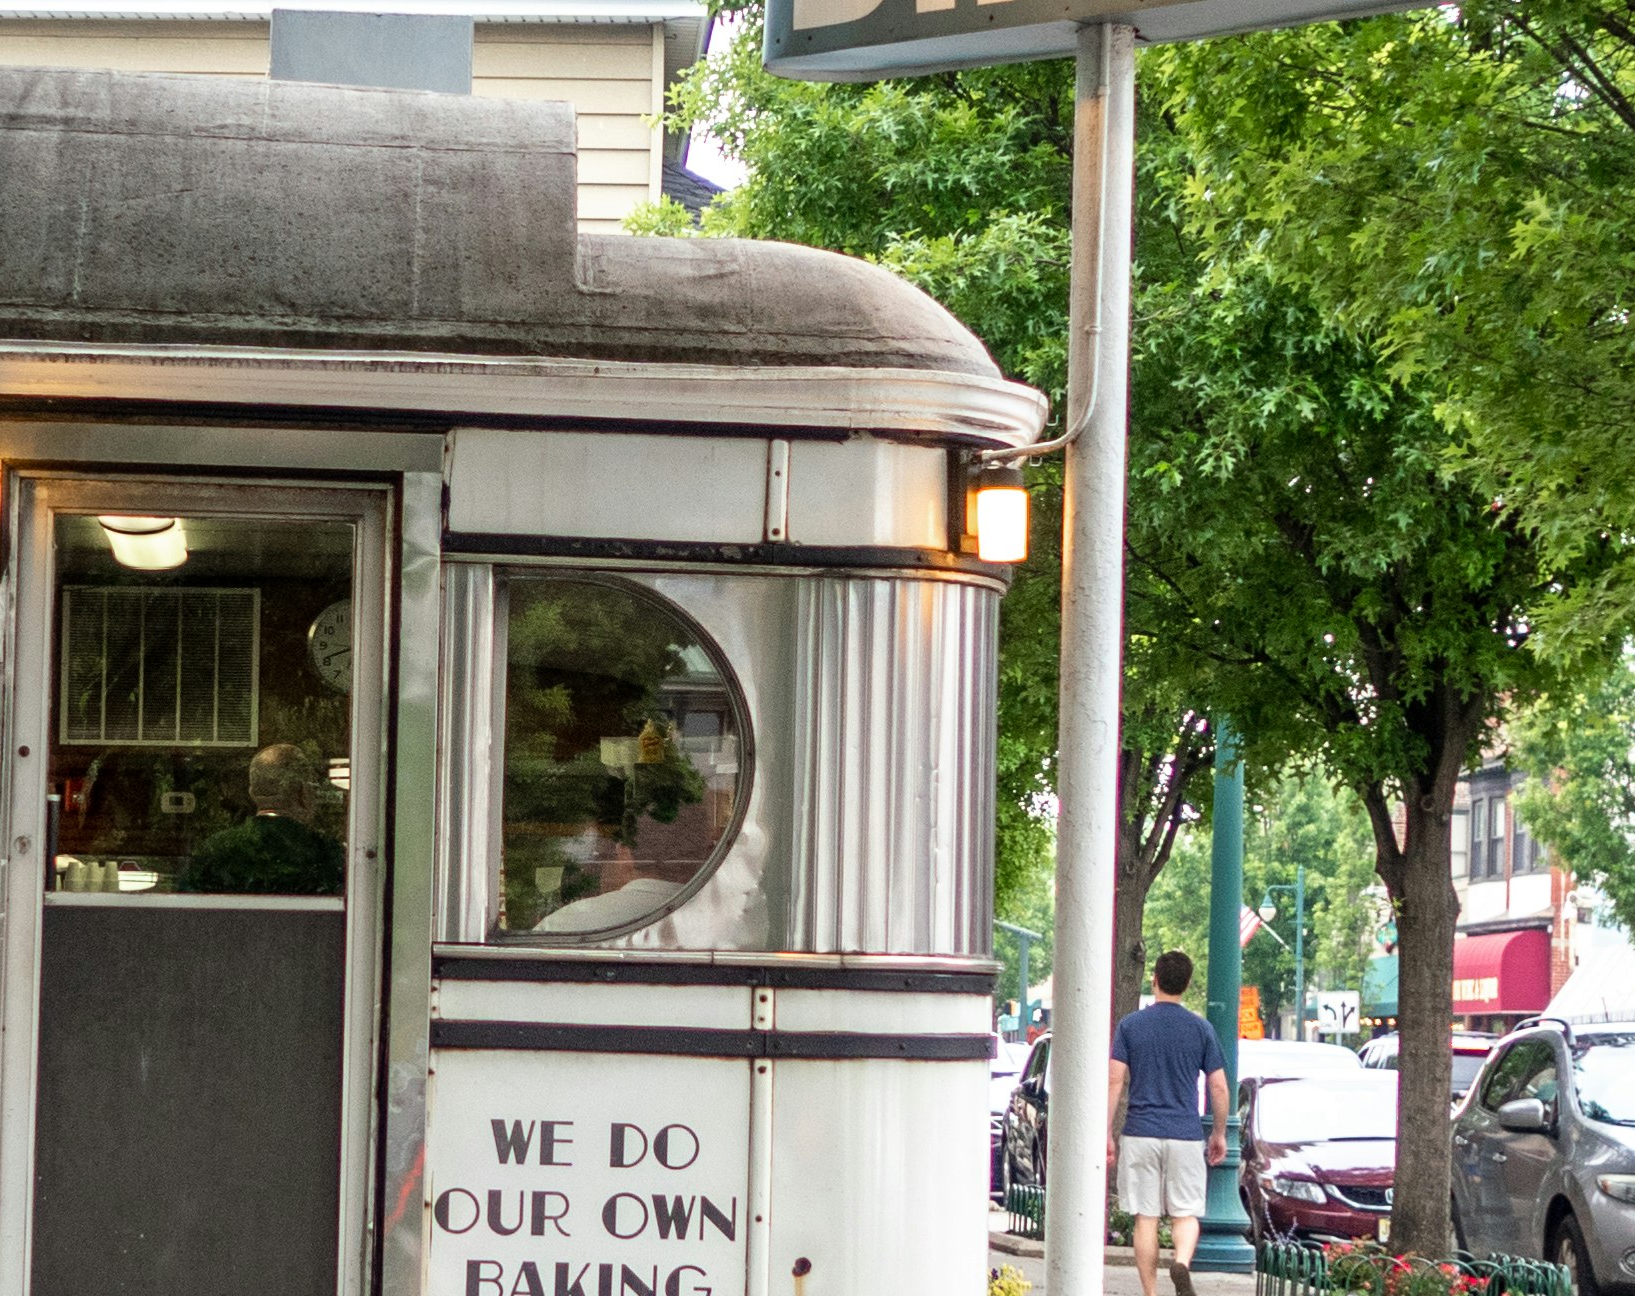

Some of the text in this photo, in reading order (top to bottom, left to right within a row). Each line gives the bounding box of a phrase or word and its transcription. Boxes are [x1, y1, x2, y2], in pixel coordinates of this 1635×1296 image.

[491, 1118, 700, 1170] WE DO
[433, 1187, 737, 1242] OUR OWN
